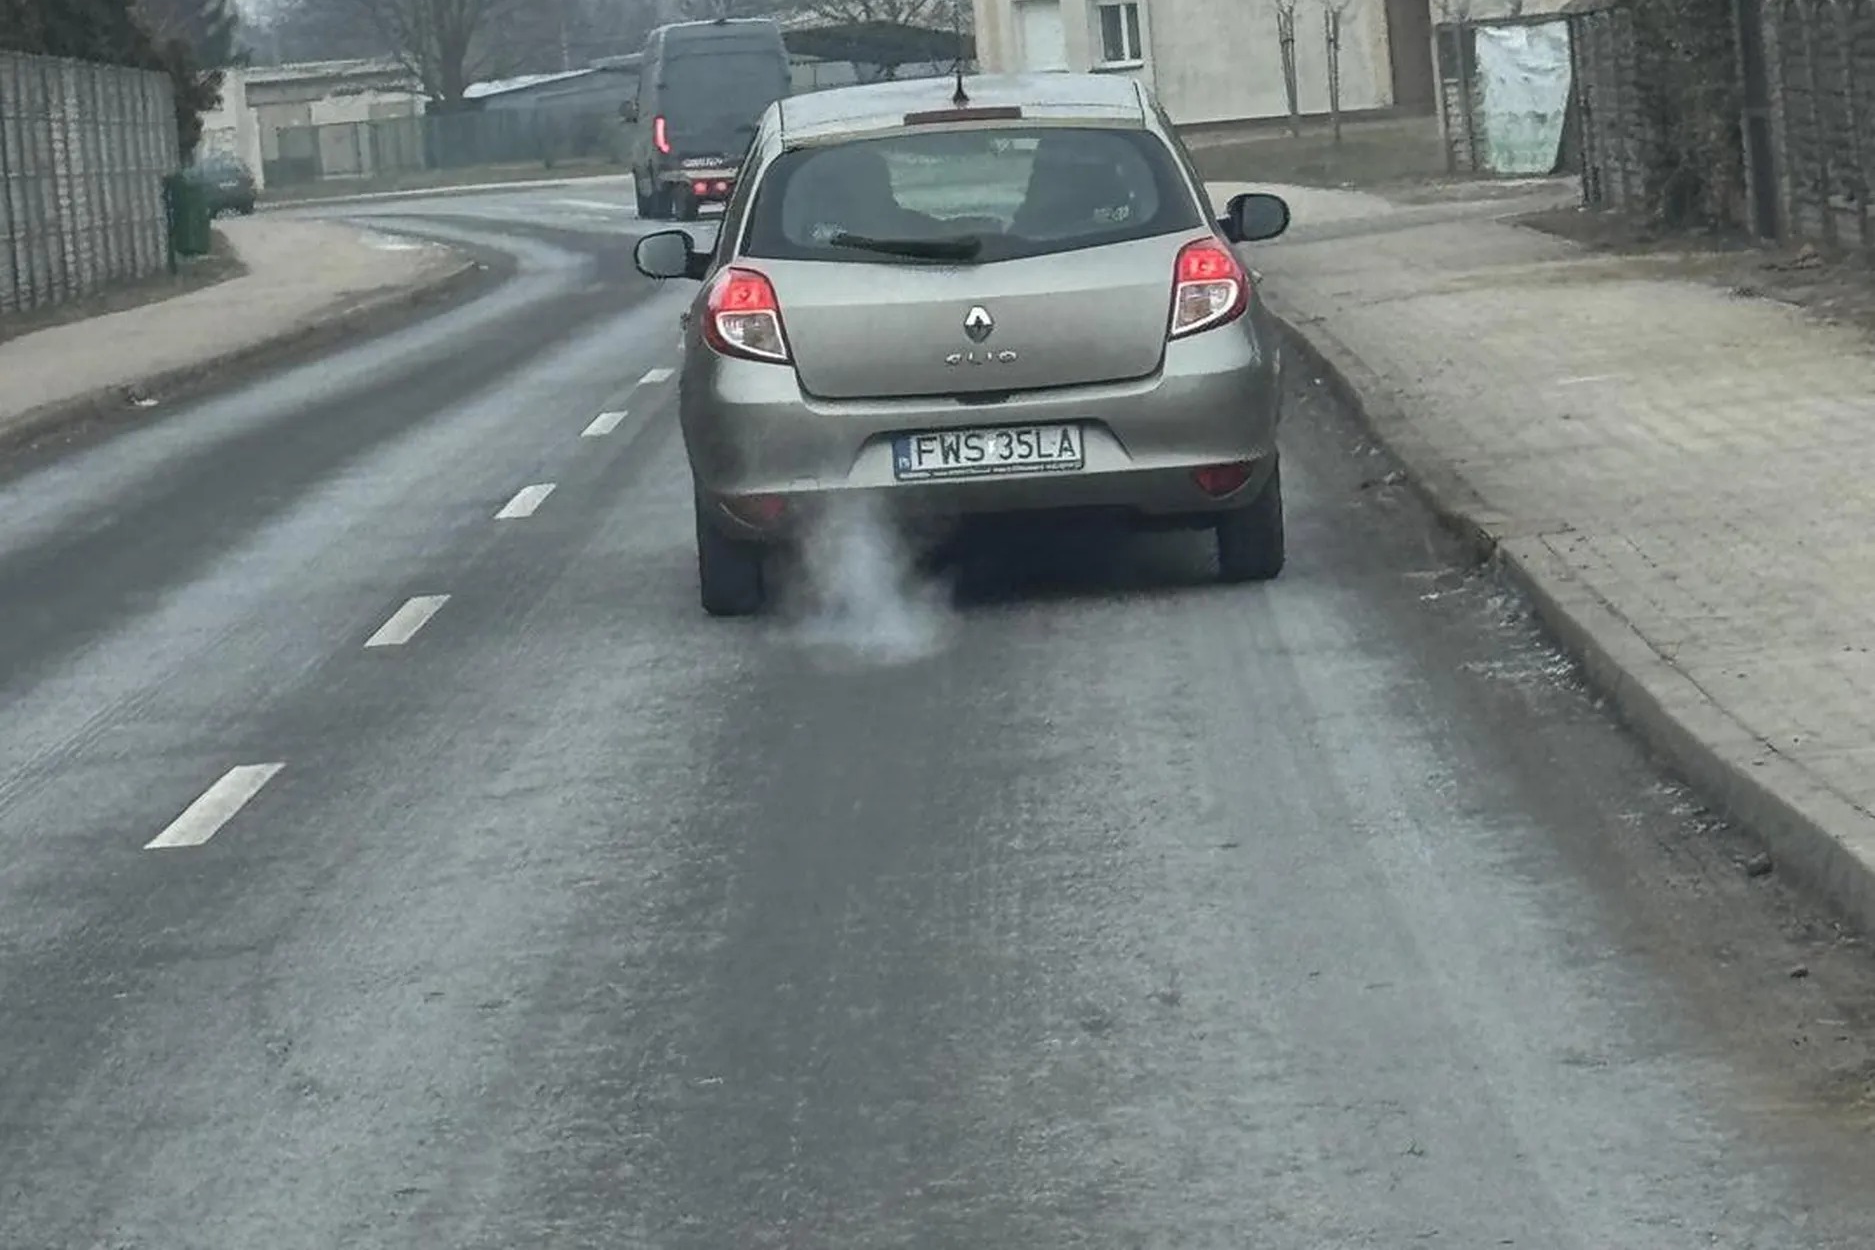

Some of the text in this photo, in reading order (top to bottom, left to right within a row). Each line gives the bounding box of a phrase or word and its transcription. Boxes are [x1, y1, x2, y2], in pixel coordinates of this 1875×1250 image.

[944, 350, 1017, 365] CLIO
[916, 433, 986, 466] FWS
[997, 427, 1076, 460] 35LA
